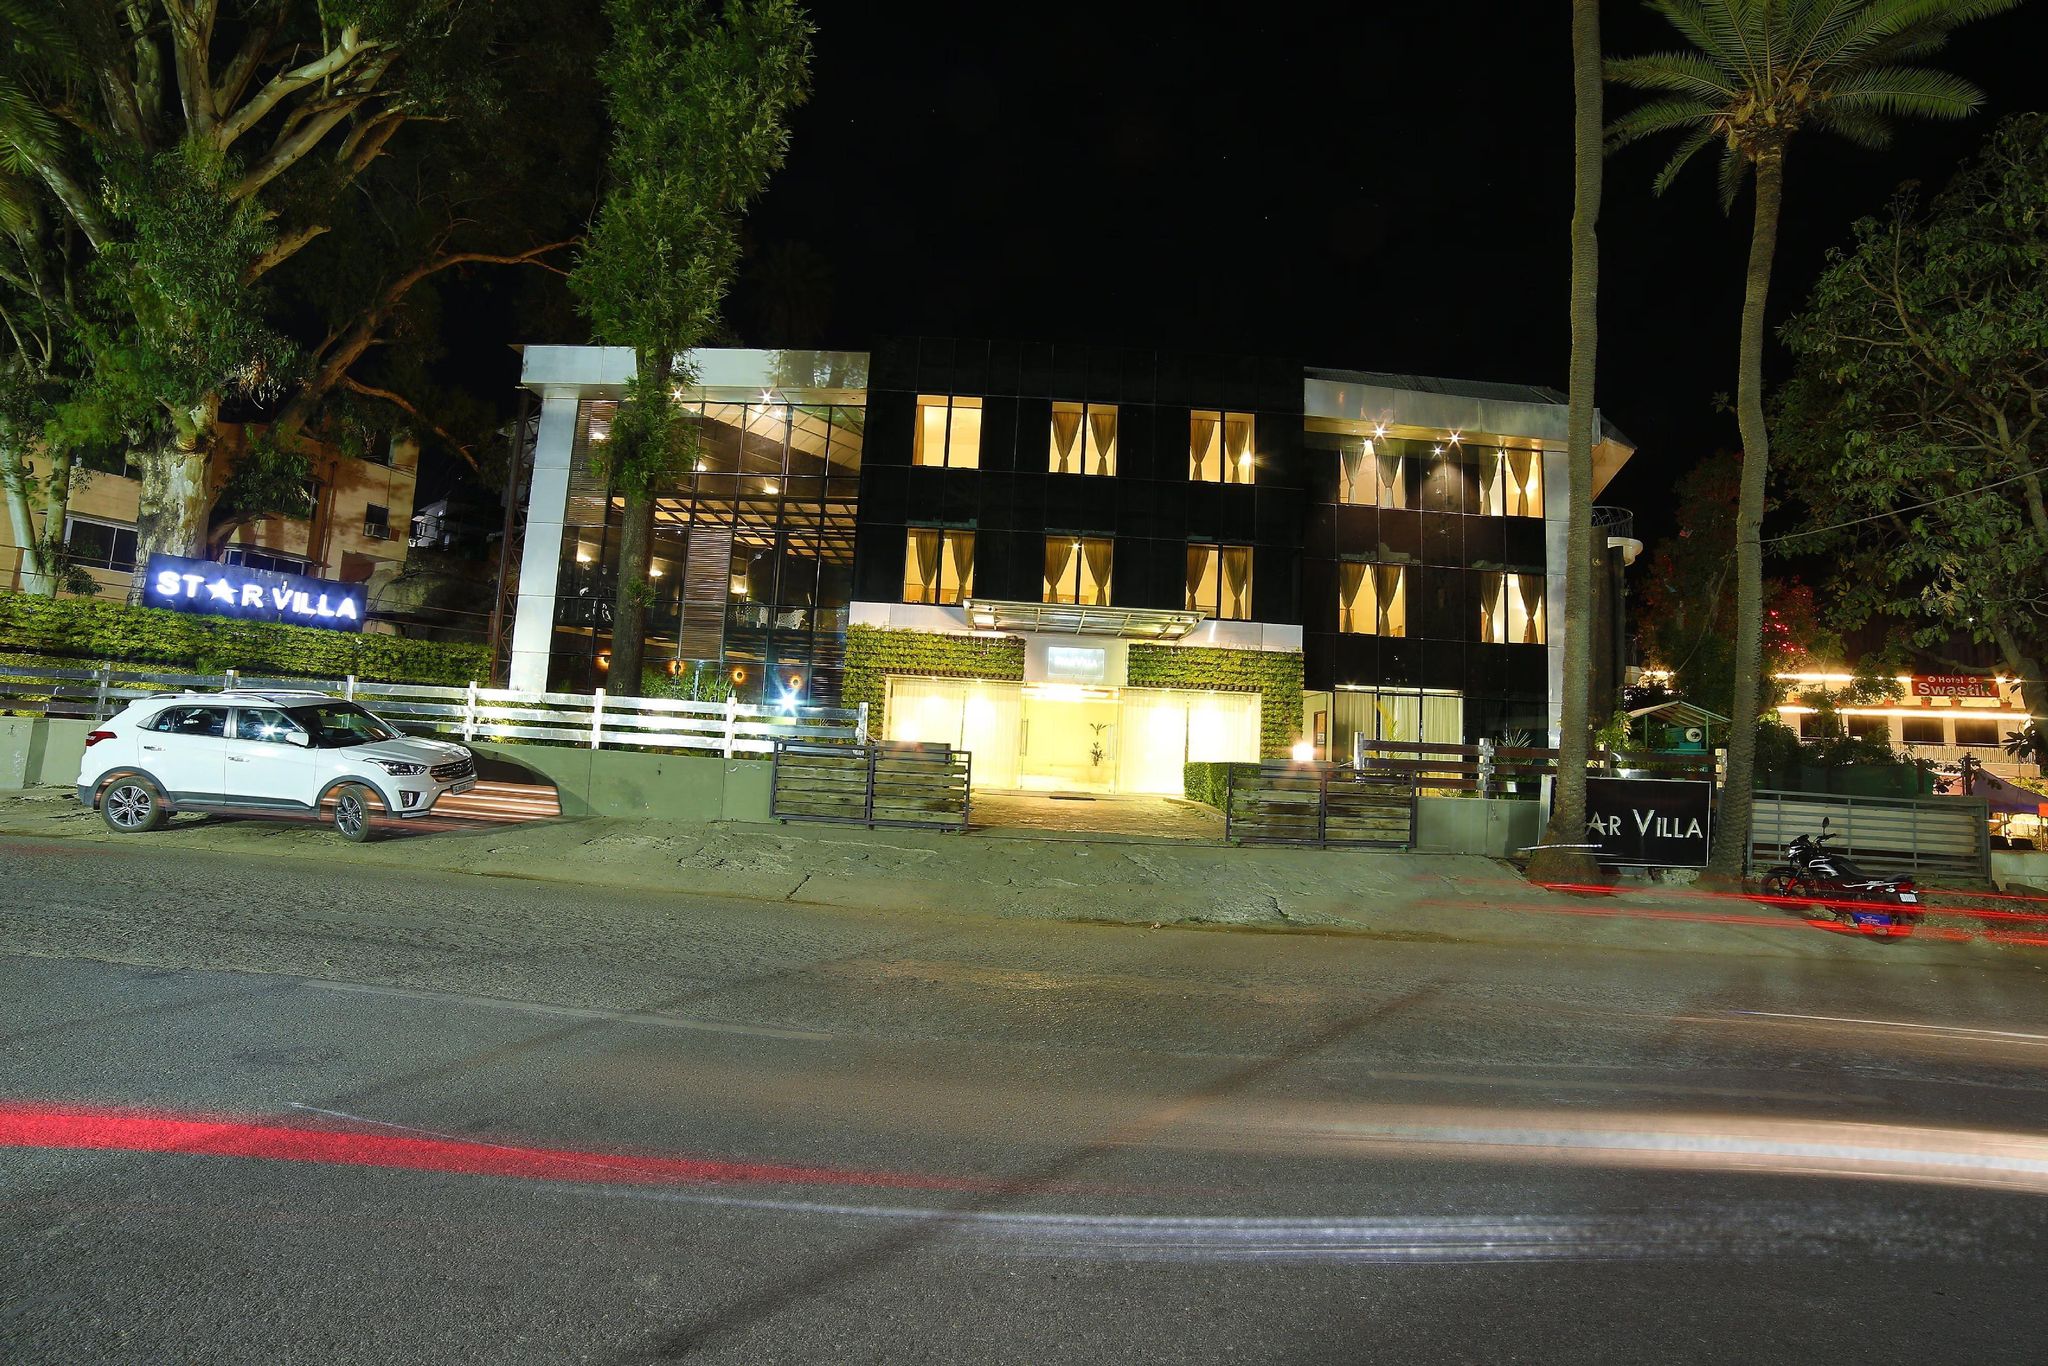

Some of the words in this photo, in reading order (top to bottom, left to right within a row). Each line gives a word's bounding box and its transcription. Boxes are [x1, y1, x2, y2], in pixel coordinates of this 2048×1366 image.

[271, 586, 358, 620] VILLA
[1918, 682, 1992, 697] Swastik
[1938, 676, 1964, 684] Hotel
[1585, 811, 1622, 836] AR
[1632, 808, 1703, 839] VILLA
